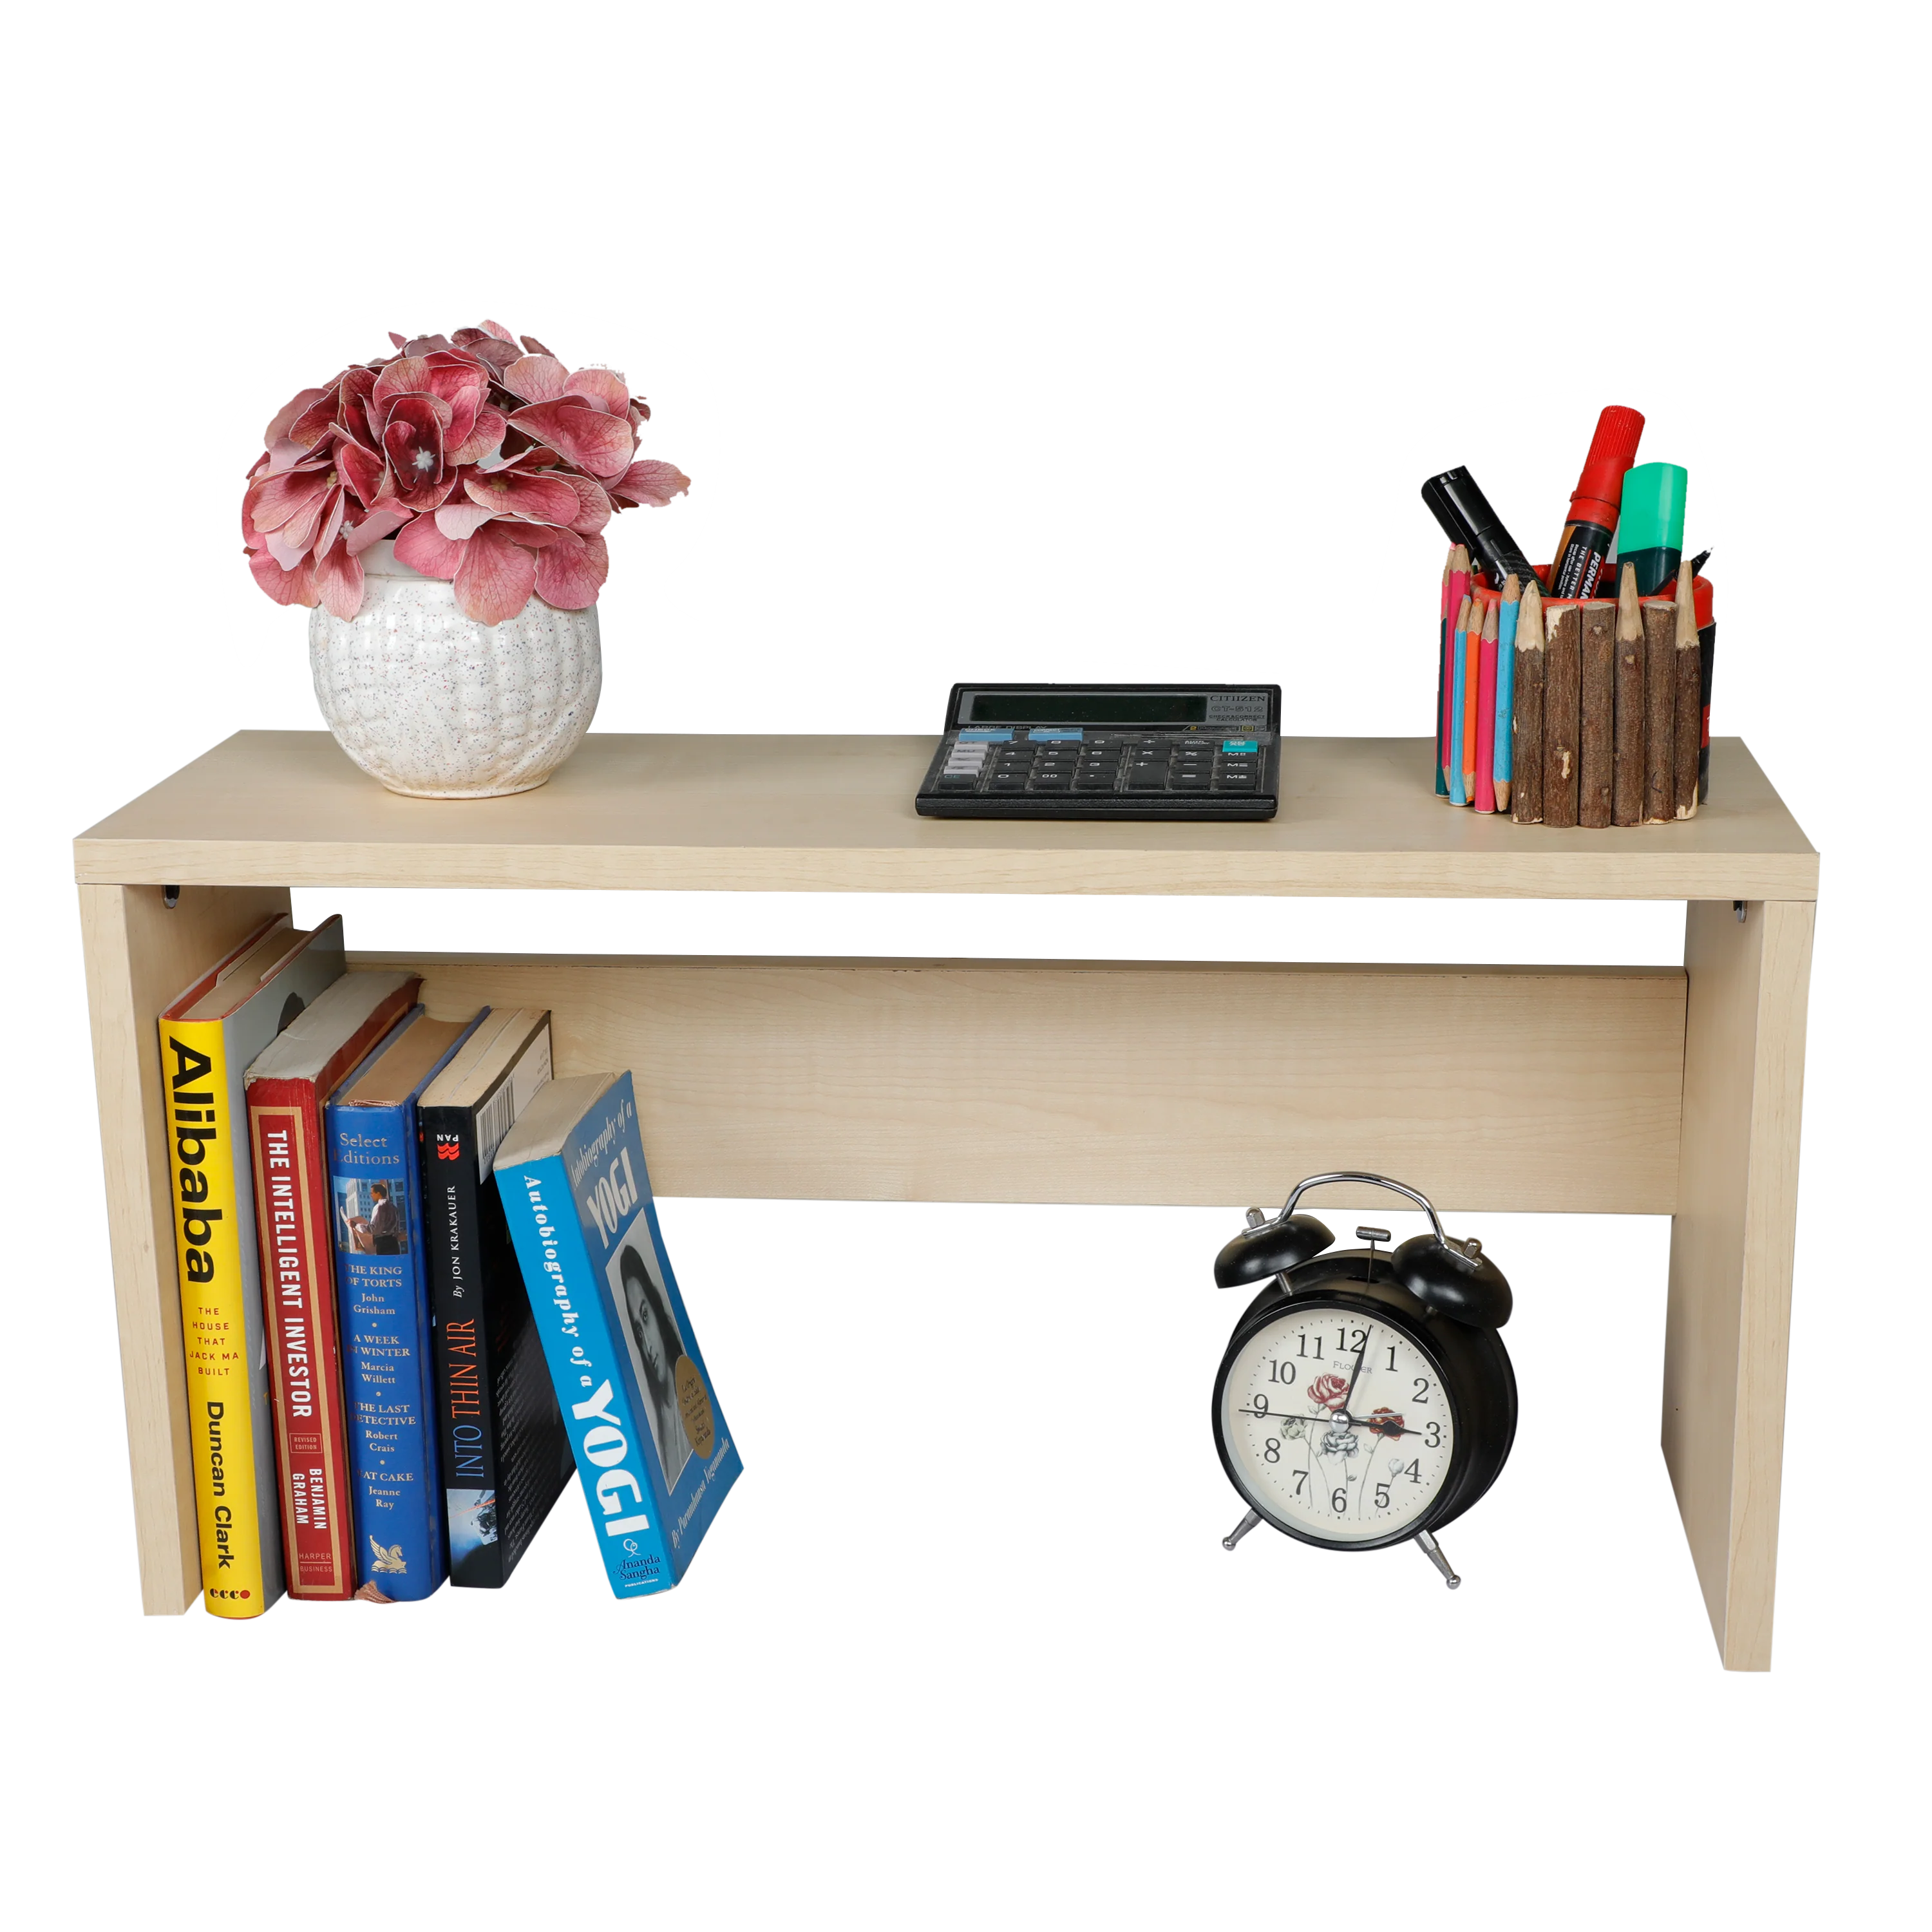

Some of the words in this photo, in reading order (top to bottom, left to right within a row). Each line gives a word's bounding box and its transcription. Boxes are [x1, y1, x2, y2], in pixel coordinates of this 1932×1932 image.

[1578, 546, 1587, 560] THE
[1570, 562, 1582, 591] BETTER
[267, 1130, 290, 1169] THE
[339, 1133, 387, 1148] Select
[571, 1117, 616, 1191] Autobiography
[618, 1099, 625, 1133] of
[626, 1102, 632, 1118] a
[169, 1036, 223, 1283] Alibaba
[586, 1146, 638, 1249] YOGI
[447, 1186, 459, 1251] KRAKAUER
[271, 1176, 303, 1309] INTELLIGENT
[451, 1256, 463, 1280] JON
[524, 1175, 579, 1338] Autobiography
[362, 1278, 402, 1287] TORTS
[370, 1266, 402, 1275] KING
[361, 1293, 384, 1302] John
[453, 1285, 464, 1298] By
[354, 1305, 395, 1314] Grisham
[193, 1321, 229, 1330] HOUSE
[446, 1318, 477, 1357] AIR
[197, 1337, 225, 1345] THAT
[361, 1347, 410, 1356] WINTER
[364, 1335, 399, 1344] WEEK
[1296, 1334, 1324, 1360] 11
[1336, 1327, 1367, 1354] 12
[189, 1351, 215, 1360] JACK
[284, 1318, 312, 1417] INVESTOR
[361, 1361, 394, 1371] Marcia
[570, 1346, 592, 1367] of
[1333, 1361, 1372, 1374] FLOER
[1385, 1346, 1398, 1372] 1
[198, 1367, 229, 1376] BUILT
[361, 1374, 395, 1383] Willett
[580, 1375, 592, 1387] a
[1268, 1359, 1296, 1385] 10
[449, 1363, 480, 1419] THIN
[1412, 1378, 1429, 1403] 2
[379, 1405, 410, 1413] LAST
[1253, 1394, 1269, 1418] 9
[365, 1430, 398, 1440] Robert
[1425, 1421, 1441, 1448] 3
[207, 1401, 225, 1497] Duncan
[369, 1443, 395, 1452] Crais
[453, 1425, 484, 1477] INTO
[572, 1379, 649, 1537] YOGI
[1264, 1437, 1280, 1463] 8
[380, 1473, 413, 1481] CAKE
[1292, 1470, 1309, 1495] 7
[1404, 1458, 1422, 1483] 4
[292, 1473, 309, 1524] GRAHAM
[309, 1468, 327, 1530] BENJAMIN
[368, 1486, 401, 1496] Jeanne
[1331, 1488, 1347, 1513] 6
[1374, 1482, 1390, 1508] 5
[375, 1499, 394, 1510] Ray
[214, 1506, 234, 1569] Clark
[671, 1530, 680, 1549] By
[612, 1554, 661, 1574] Ananda
[620, 1566, 660, 1580] Sangha
[625, 1578, 659, 1587] PUBLICATIONS
